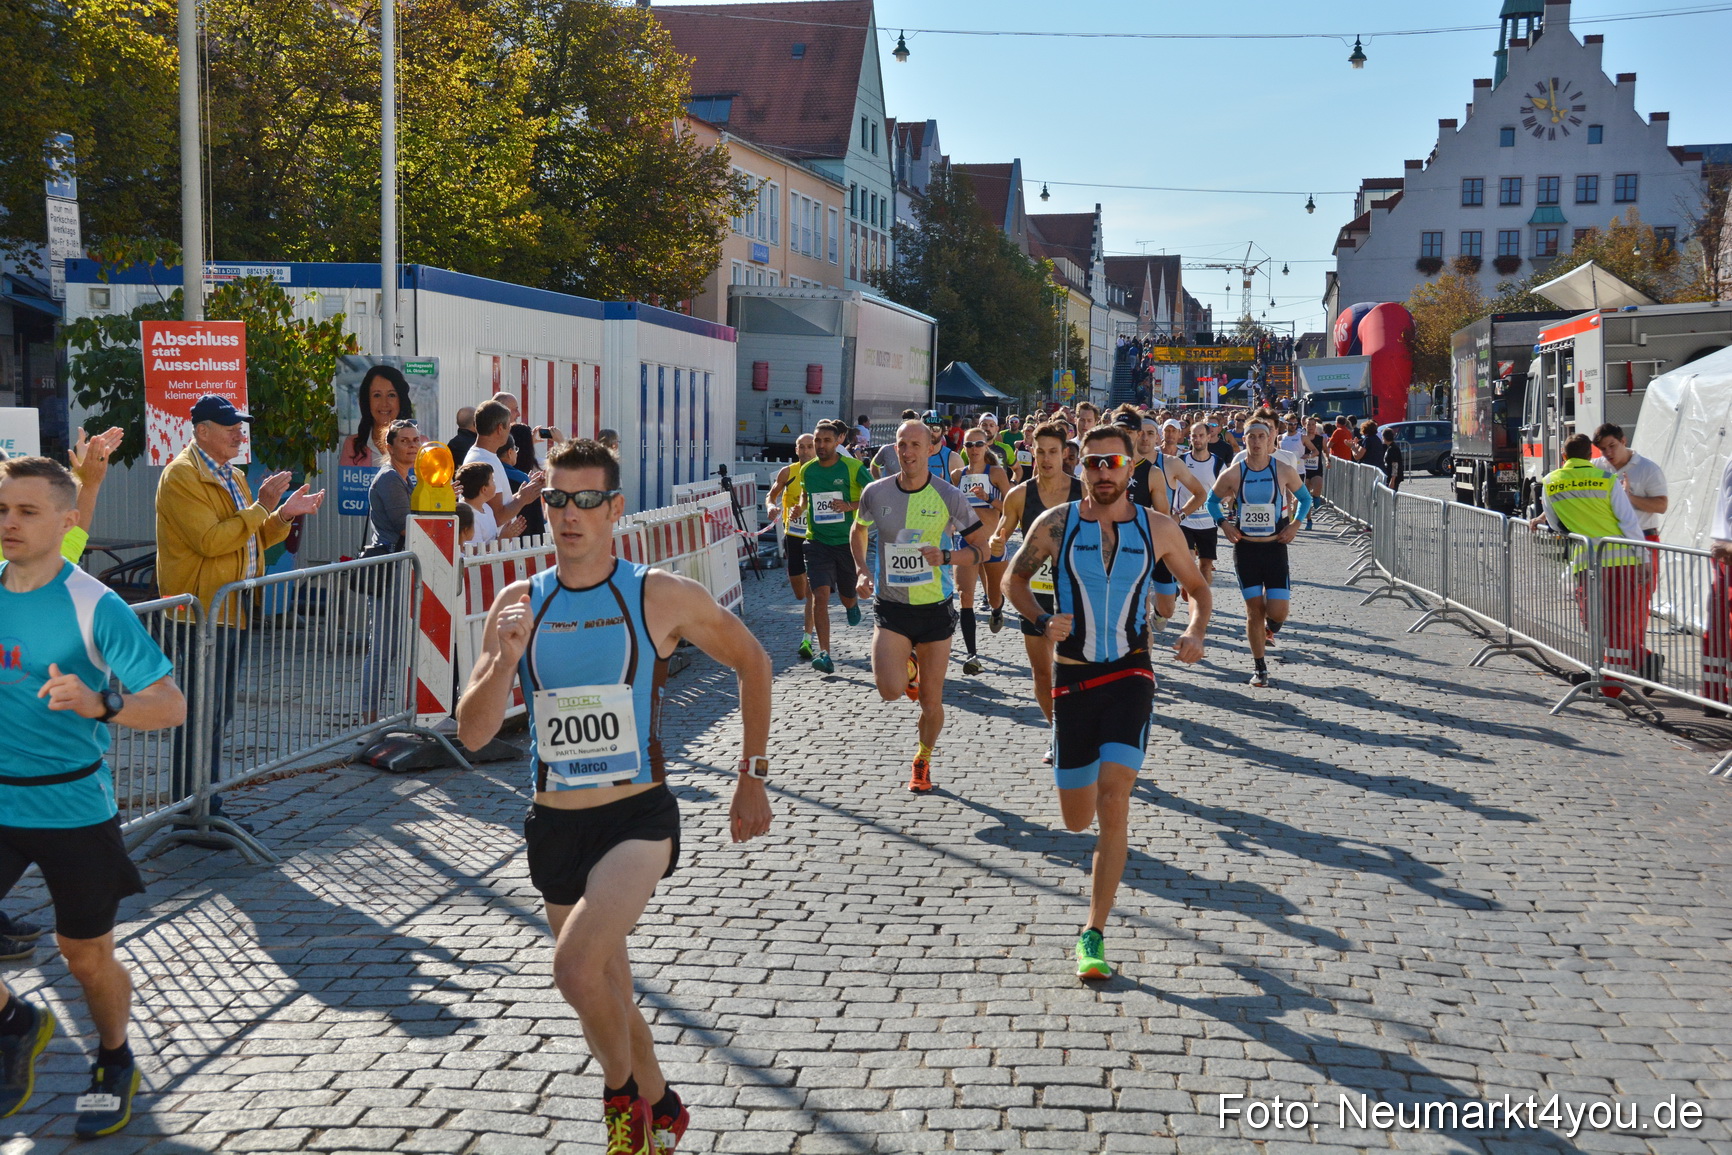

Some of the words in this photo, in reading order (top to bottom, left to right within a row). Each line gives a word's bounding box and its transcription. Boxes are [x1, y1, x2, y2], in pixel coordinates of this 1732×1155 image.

[50, 213, 77, 225] Parkschein
[151, 330, 239, 346] Abschluss
[151, 347, 181, 357] statt
[1186, 349, 1222, 359] START
[153, 358, 240, 371] Ausschluss!
[168, 381, 193, 389] Mehr
[195, 380, 223, 389] Lehrer
[225, 380, 237, 389] für
[164, 390, 201, 400] kleinere
[342, 499, 364, 510] CSU
[1245, 512, 1270, 523] 2393
[891, 555, 924, 570] 2001
[558, 695, 602, 708] BOCK
[547, 711, 620, 747] 2000
[556, 748, 578, 758] PARTL
[569, 761, 608, 775] Marco
